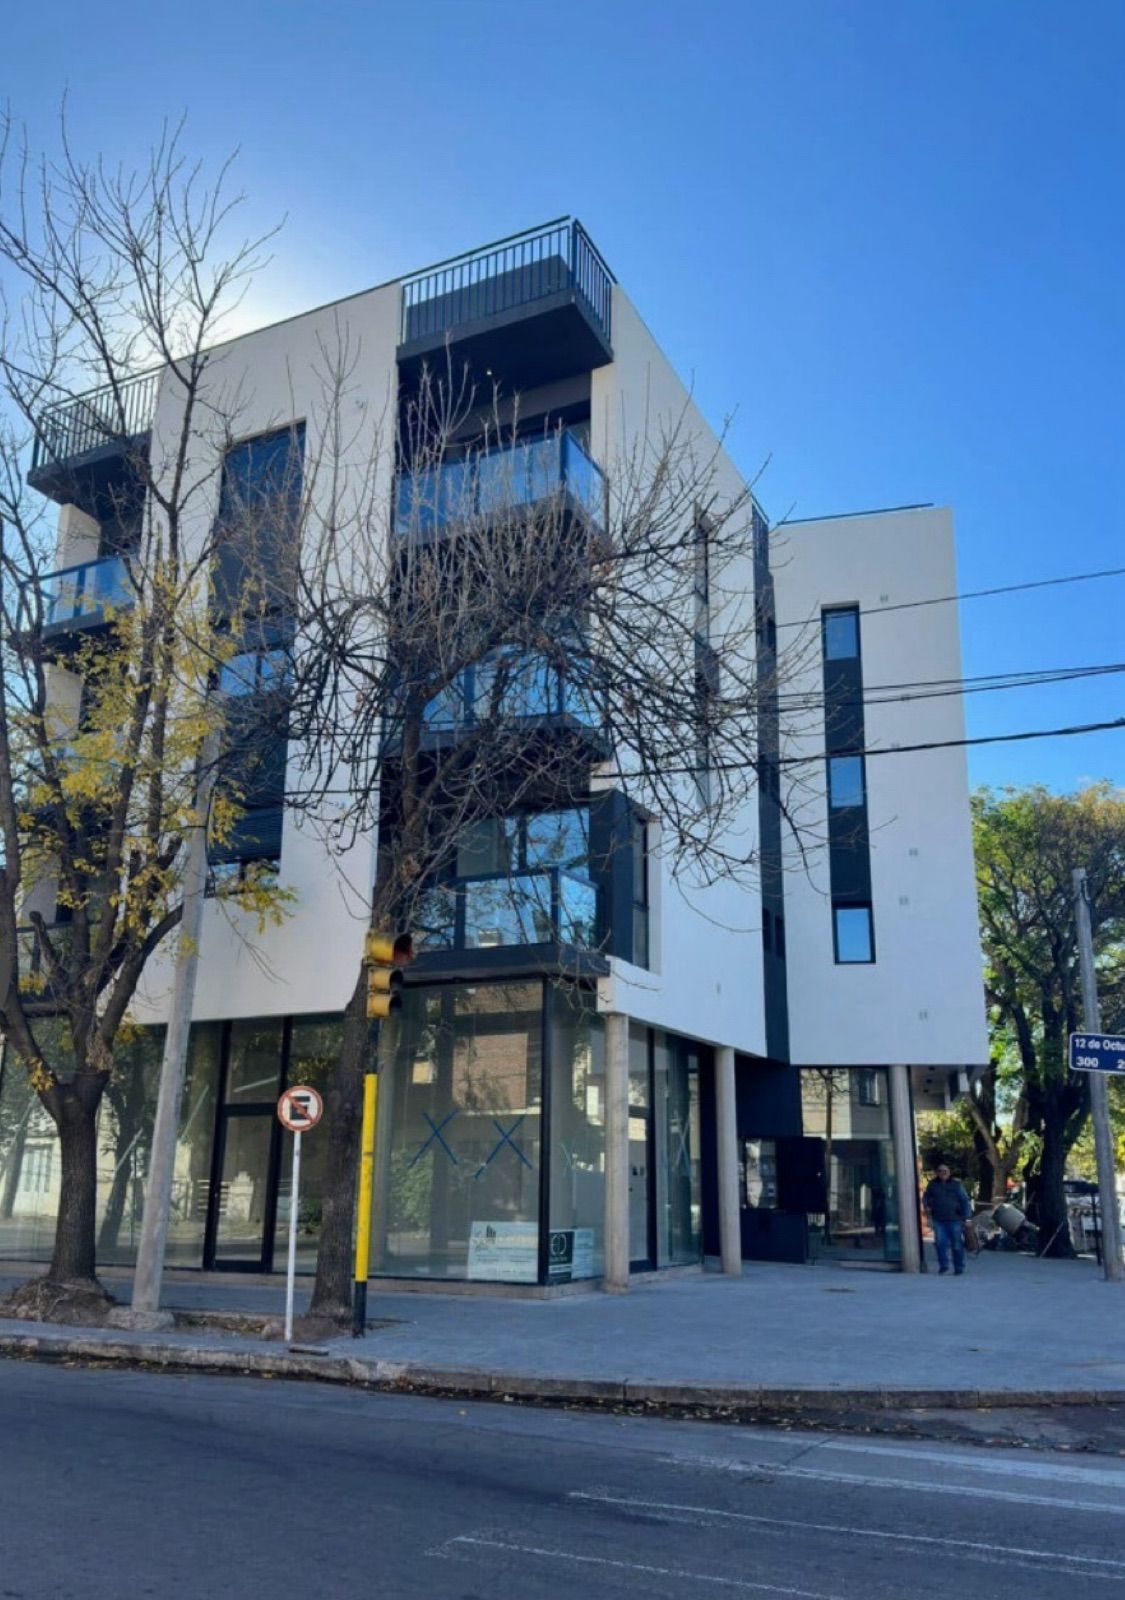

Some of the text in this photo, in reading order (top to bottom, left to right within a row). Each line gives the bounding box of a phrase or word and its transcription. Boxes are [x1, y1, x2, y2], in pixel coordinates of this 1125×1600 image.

[1075, 1038, 1087, 1049] 12
[1088, 1038, 1101, 1050] de
[1076, 1056, 1099, 1068] 300
